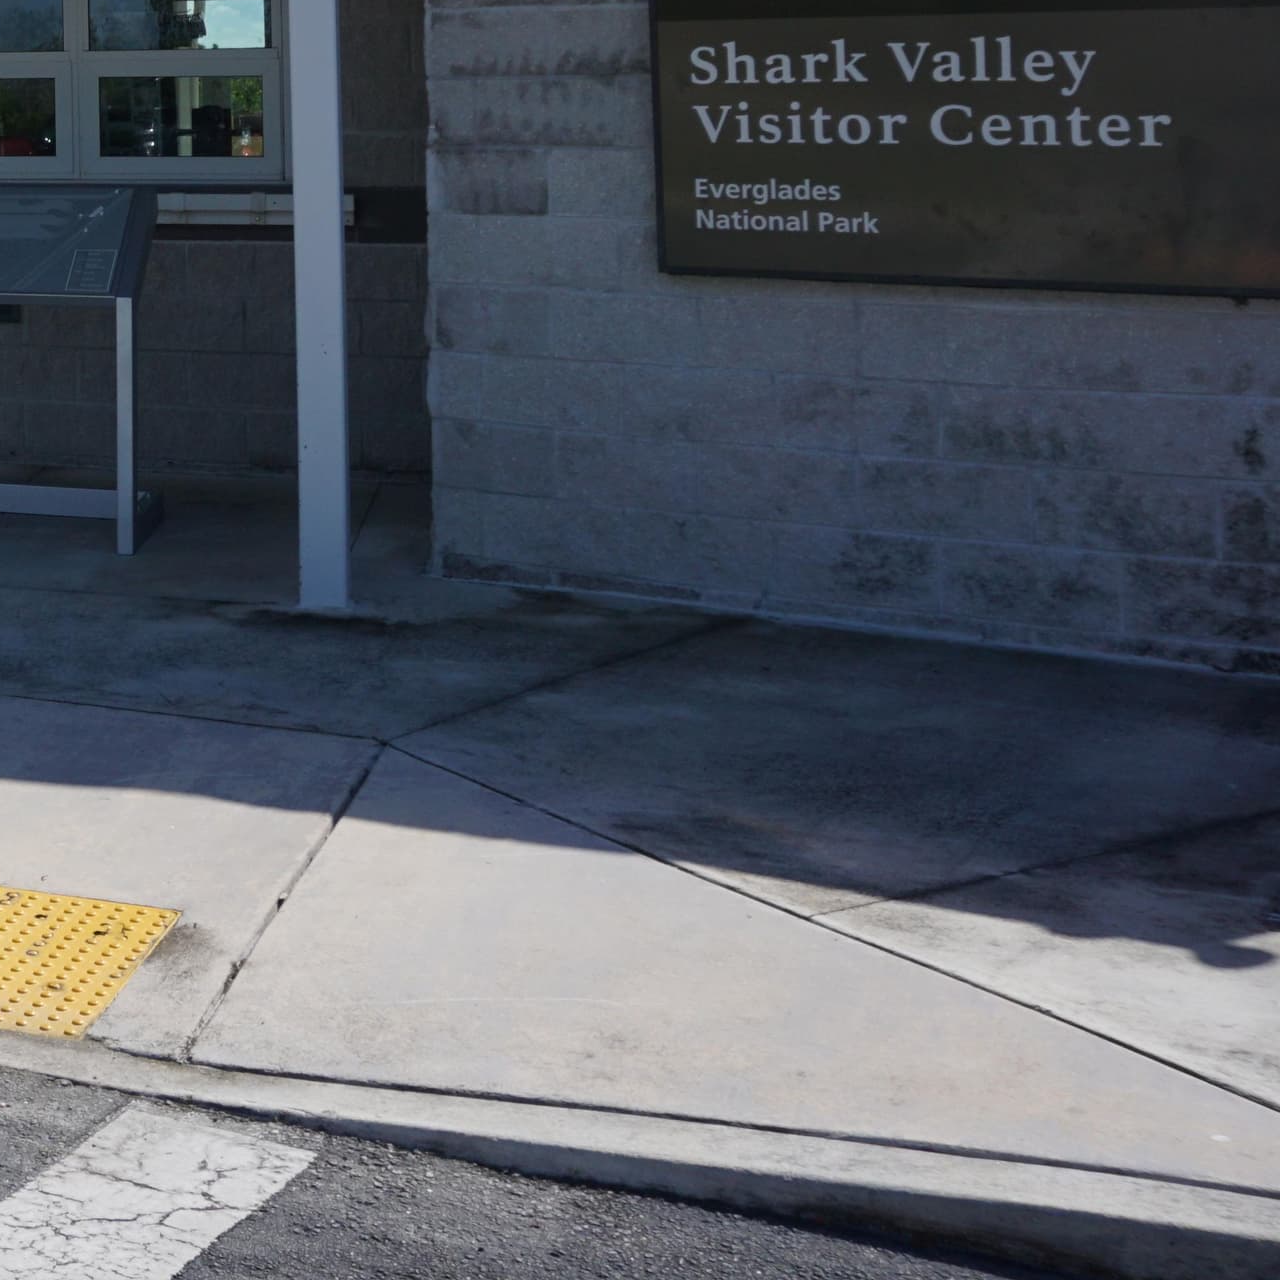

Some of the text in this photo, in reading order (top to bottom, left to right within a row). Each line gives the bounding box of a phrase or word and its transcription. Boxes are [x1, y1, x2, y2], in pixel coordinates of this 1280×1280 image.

[690, 36, 1095, 96] Shark Valley
[693, 102, 1172, 147] Visitor Center
[694, 178, 841, 204] Everglades
[695, 209, 879, 234] National Park
